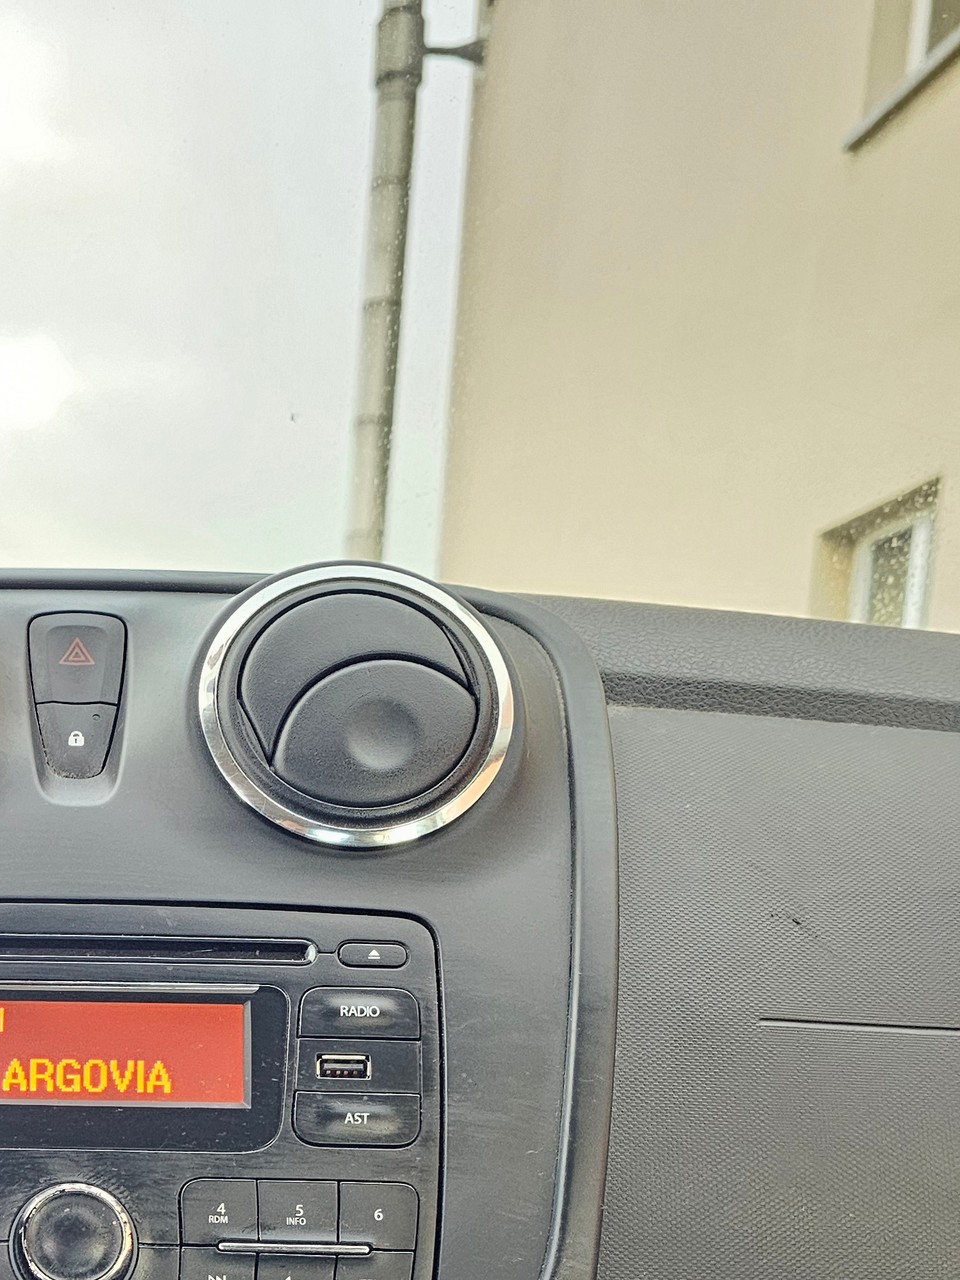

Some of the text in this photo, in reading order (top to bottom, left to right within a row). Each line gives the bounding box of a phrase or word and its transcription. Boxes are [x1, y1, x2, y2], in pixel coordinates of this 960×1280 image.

[339, 1005, 381, 1018] RADIO
[1, 1058, 172, 1094] ARGOVIA
[344, 1112, 370, 1125] AST
[215, 1202, 227, 1215] 4
[294, 1204, 304, 1217] 5
[373, 1208, 384, 1221] 6
[208, 1214, 229, 1224] RDM
[286, 1217, 307, 1226] INFO
